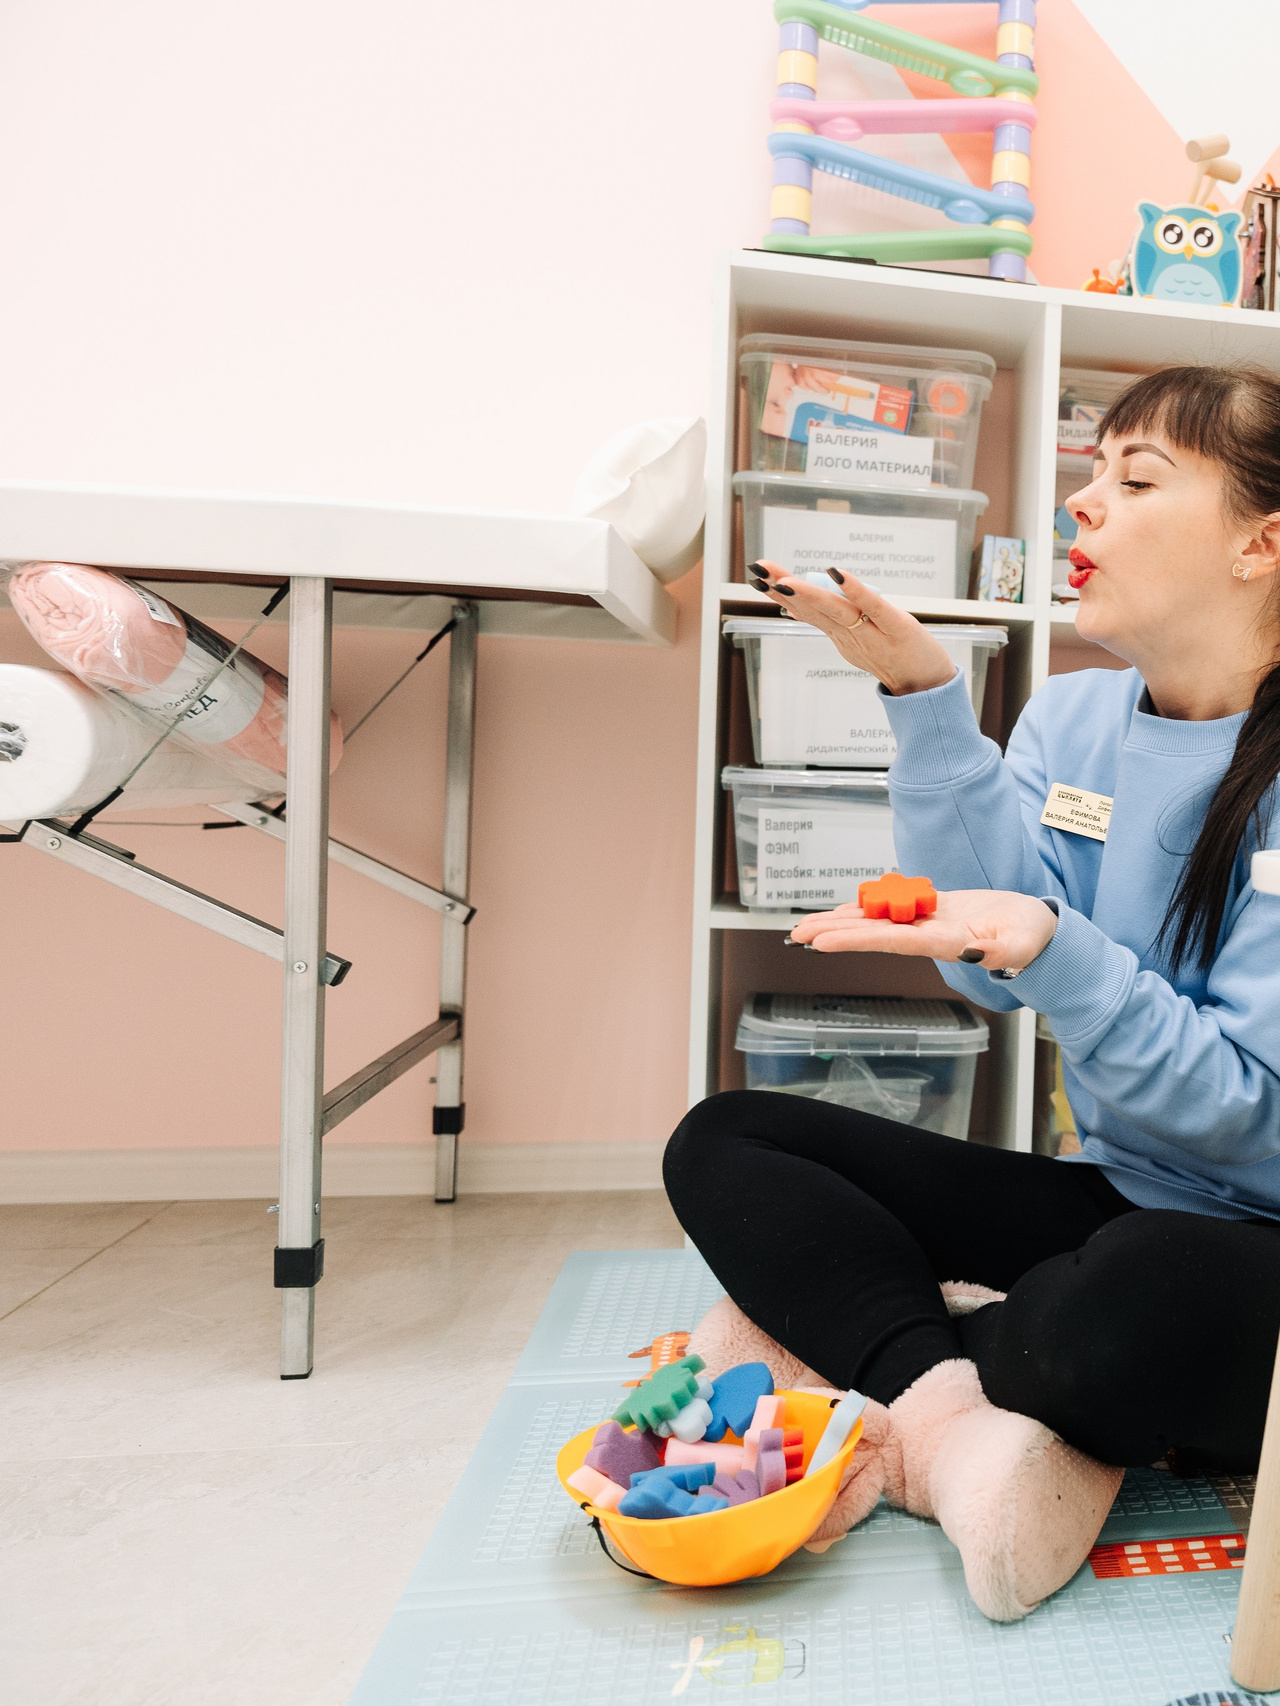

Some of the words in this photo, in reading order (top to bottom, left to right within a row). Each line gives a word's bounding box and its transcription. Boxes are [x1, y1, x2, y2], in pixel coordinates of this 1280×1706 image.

[815, 433, 878, 449] ВАЛЕРИЯ
[814, 456, 852, 470] ЛОГО
[856, 459, 931, 476] МАТЕРИАЛ
[849, 532, 894, 543] ВАЛЕРИЯ
[793, 549, 886, 562] ЛОГОПЕДИЧЕСКИЕ
[806, 744, 888, 754] дидактический
[1045, 811, 1074, 825] ВАЛЕРИЯ
[1070, 809, 1101, 823] ЕФИМОВА
[765, 818, 813, 834] Валерия
[765, 842, 799, 855] ФЭМП
[765, 865, 816, 879] Пособия:
[766, 891, 773, 900] и
[777, 889, 835, 899] мышление
